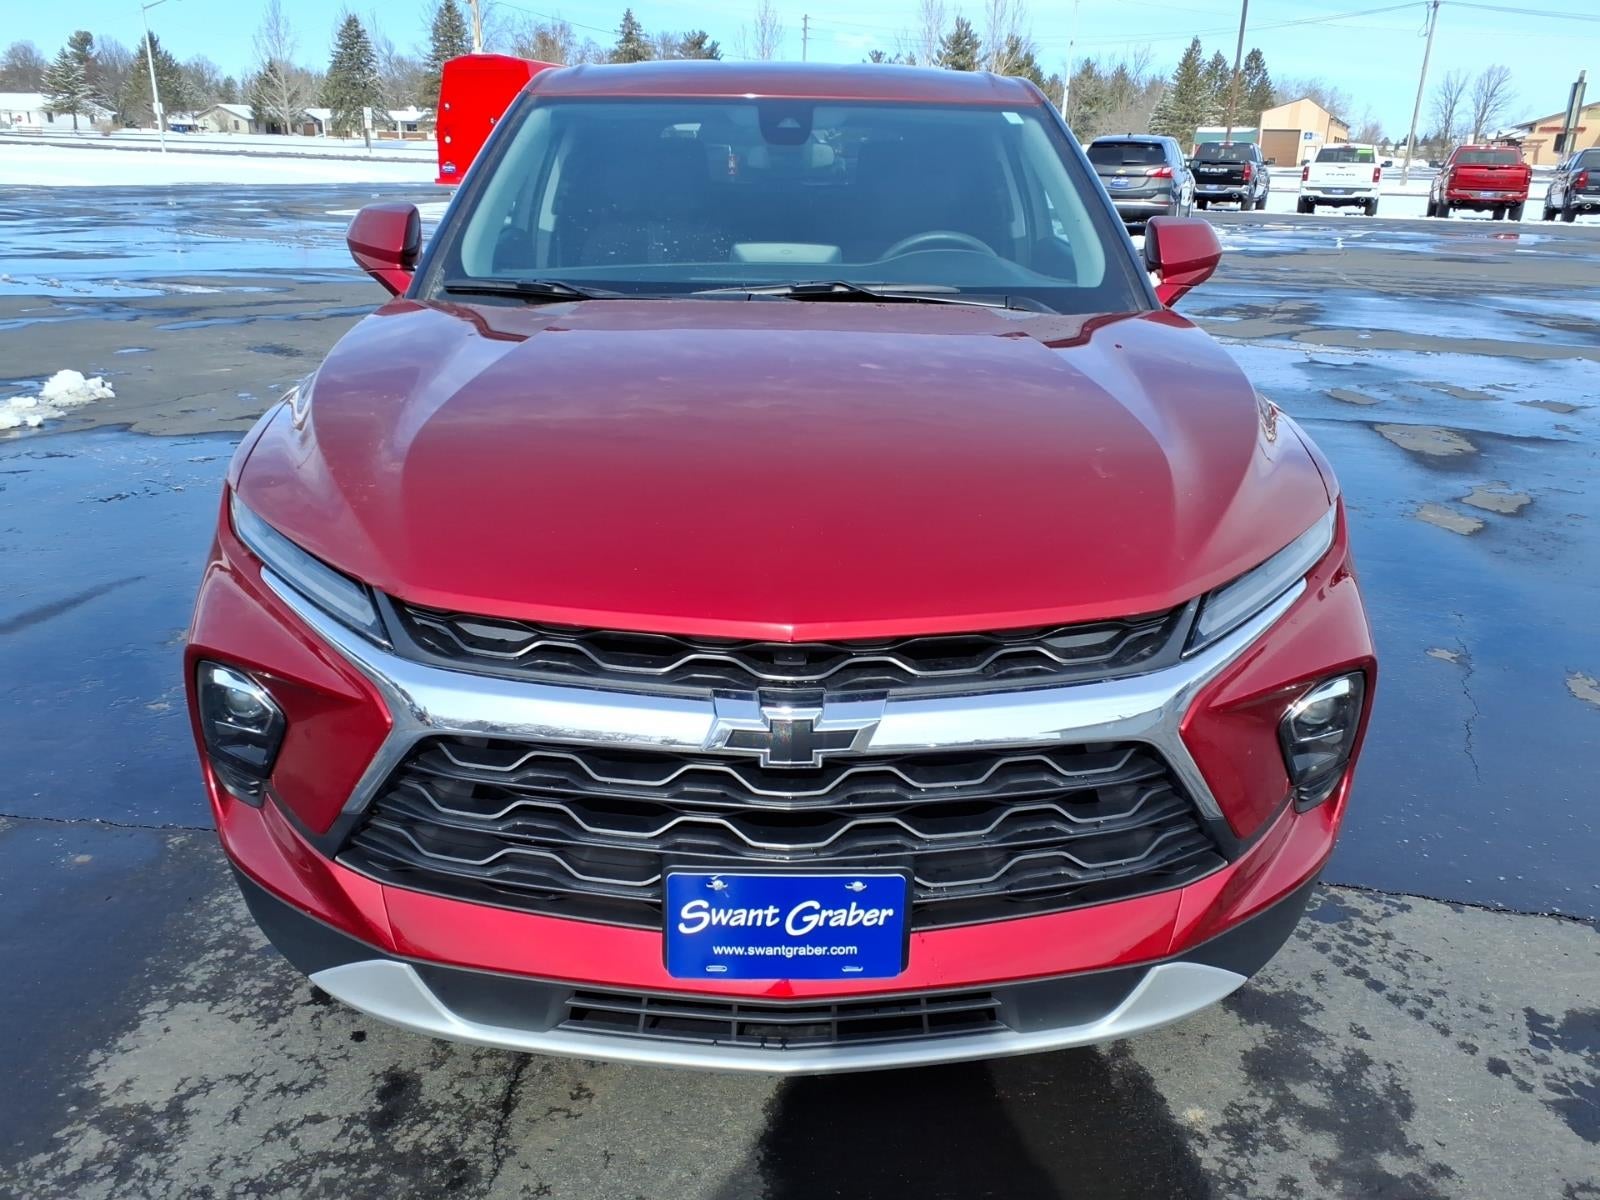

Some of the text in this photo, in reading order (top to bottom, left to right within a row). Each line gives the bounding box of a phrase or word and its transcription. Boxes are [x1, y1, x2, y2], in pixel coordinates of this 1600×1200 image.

[678, 899, 894, 936] Swant Graber
[713, 944, 858, 958] www.swantgraber.com
